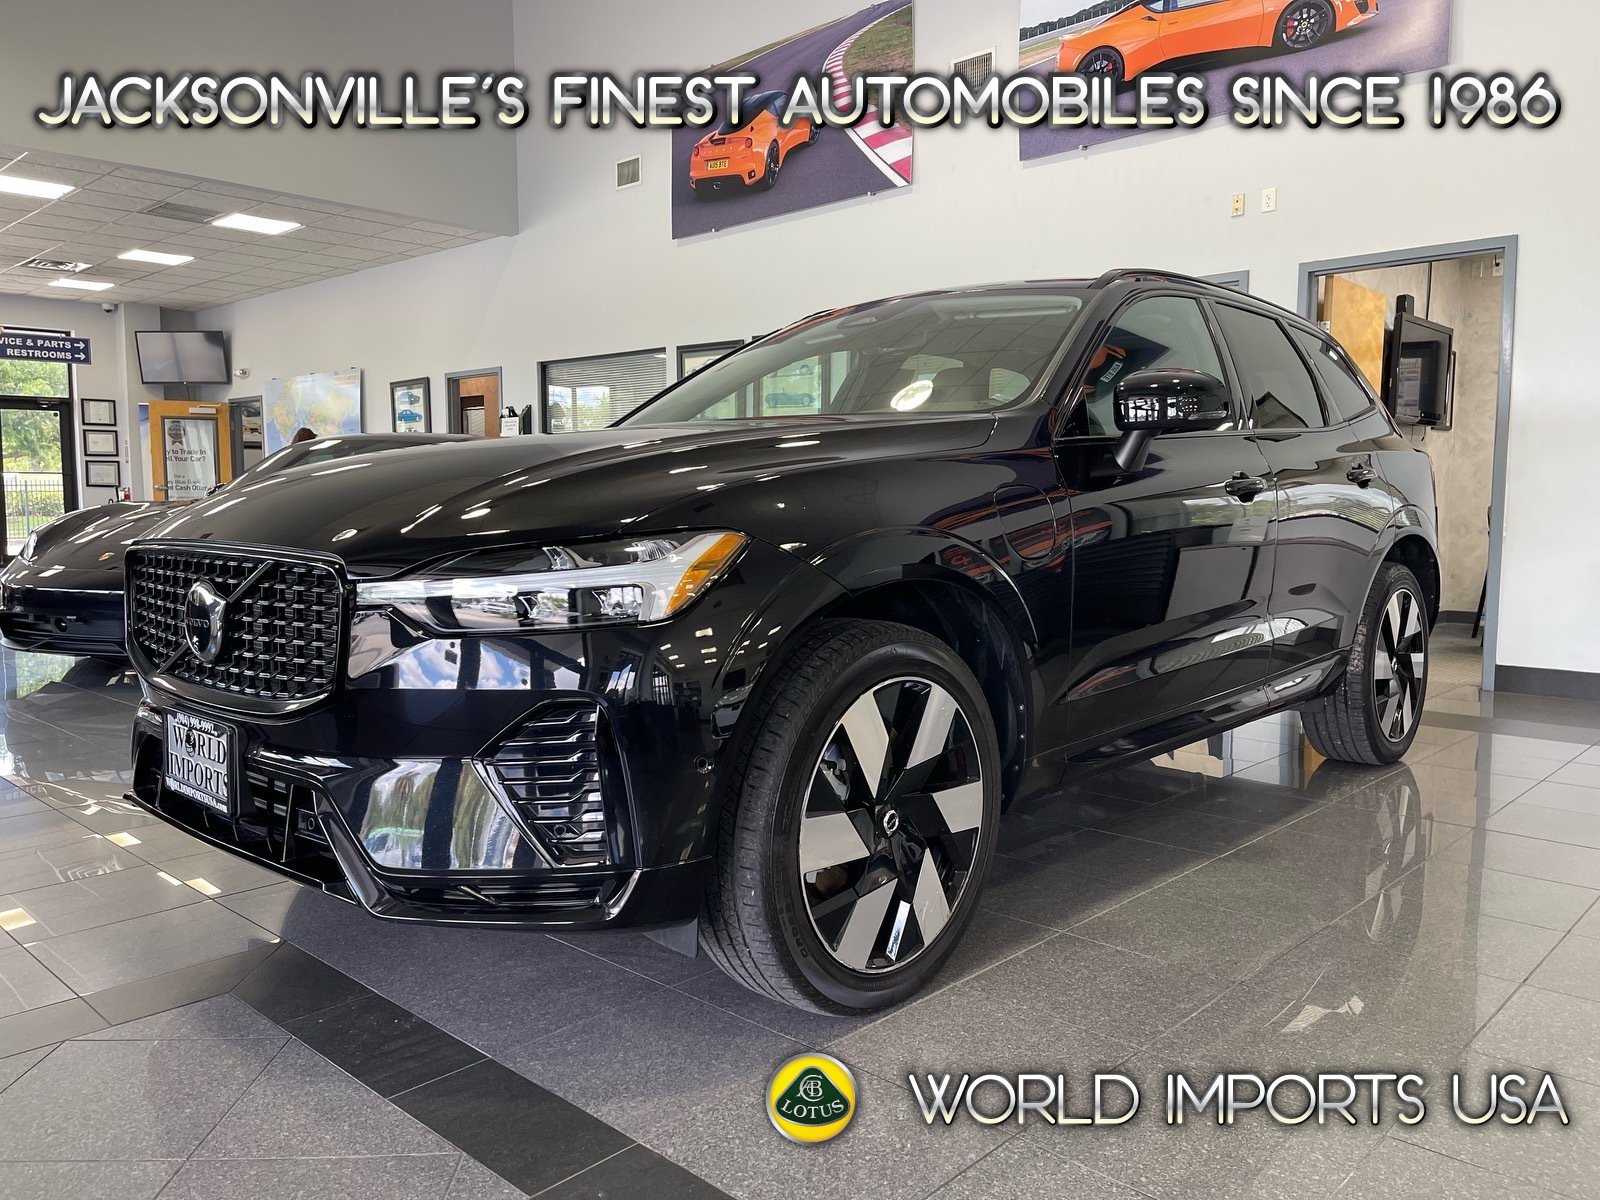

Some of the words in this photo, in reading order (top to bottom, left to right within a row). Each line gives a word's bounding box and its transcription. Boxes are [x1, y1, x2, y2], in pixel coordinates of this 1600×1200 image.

[26, 338, 34, 346] &
[37, 339, 72, 349] PARTS
[6, 348, 72, 360] RESTROOMS
[168, 752, 228, 797] IMPORTS
